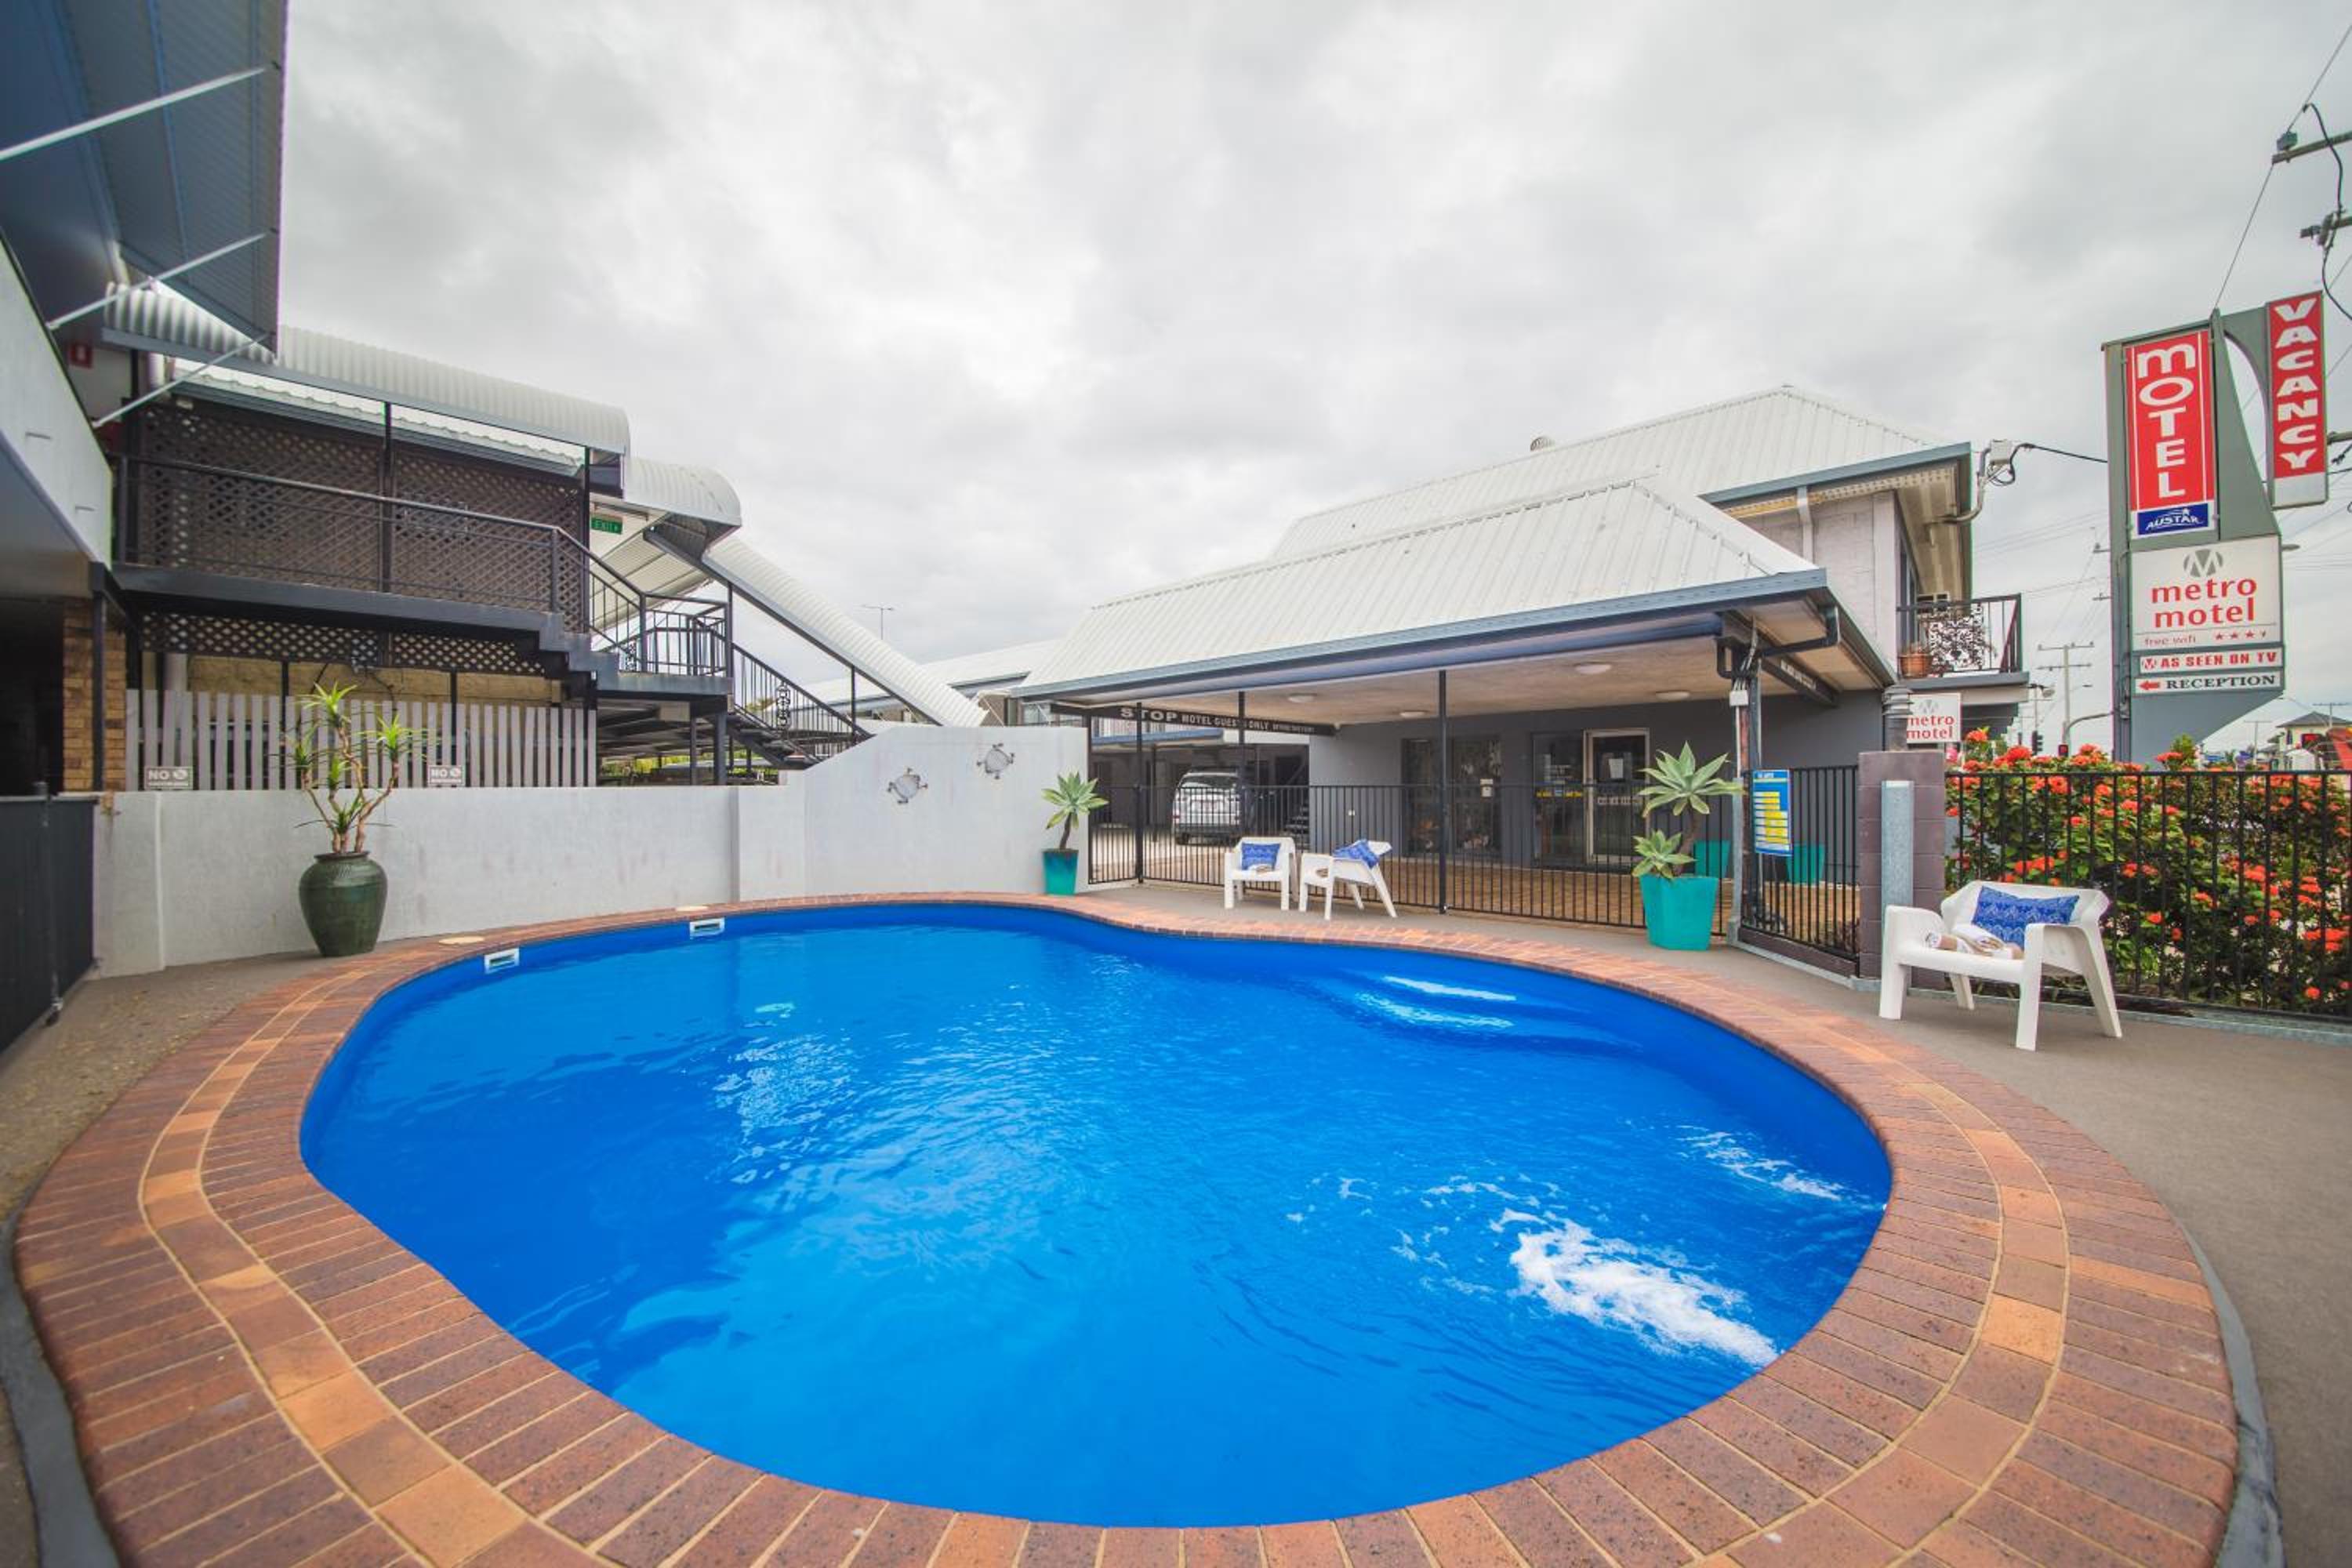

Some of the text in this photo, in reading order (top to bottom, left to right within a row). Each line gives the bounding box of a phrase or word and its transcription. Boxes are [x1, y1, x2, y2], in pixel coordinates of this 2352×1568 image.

[2274, 298, 2318, 470] VACANCY
[2136, 343, 2197, 499] MOTEL
[2151, 578, 2258, 604] metro
[2154, 597, 2255, 628] motel
[2144, 637, 2169, 646] free
[2161, 657, 2180, 669] AS
[2186, 654, 2223, 666] SEEN
[2230, 653, 2249, 665] ON
[2257, 652, 2277, 663] TV
[2166, 675, 2276, 689] RECEPTION
[1120, 706, 1178, 721] STOP
[1907, 726, 1953, 739] motel
[148, 769, 169, 780] NO
[431, 768, 447, 777] NO
